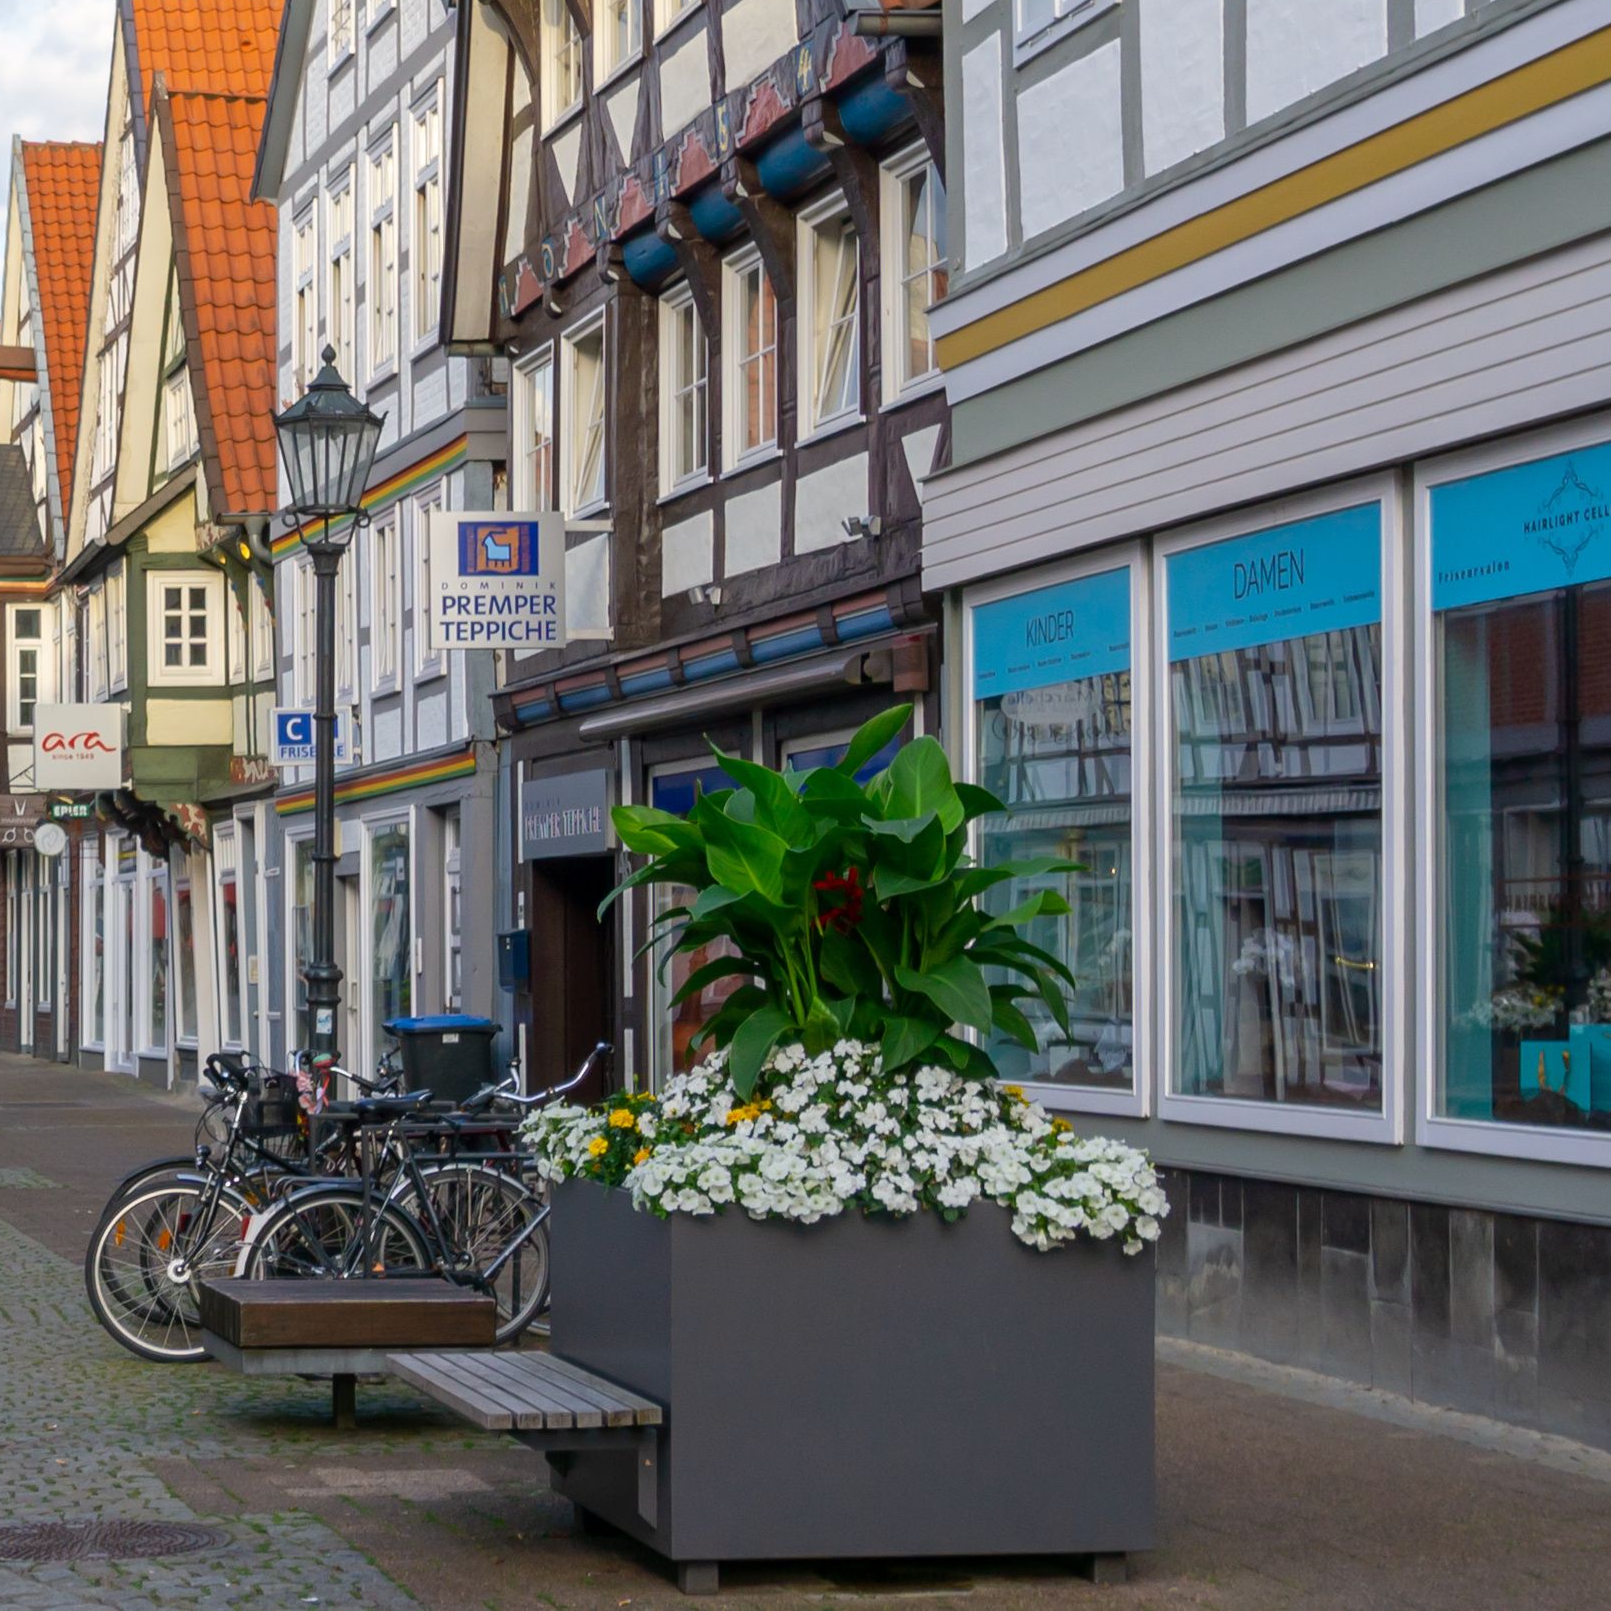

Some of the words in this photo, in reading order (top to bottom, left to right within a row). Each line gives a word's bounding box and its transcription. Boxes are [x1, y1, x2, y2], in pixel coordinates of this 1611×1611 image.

[1523, 510, 1580, 533] HAIRLIGHT
[1233, 548, 1304, 600] DAMEN
[1438, 560, 1510, 584] Friseursalon
[441, 582, 556, 590] DOMINIK
[441, 594, 557, 616] PREMPER
[439, 620, 557, 642] TEPPICHE
[1026, 609, 1075, 649] KINDER
[41, 731, 117, 753] ara
[280, 745, 344, 759] FRISEE
[51, 753, 74, 761] since
[75, 752, 95, 761] 1949
[524, 811, 561, 841] PREMPER
[562, 805, 602, 837] TEPPICHE
